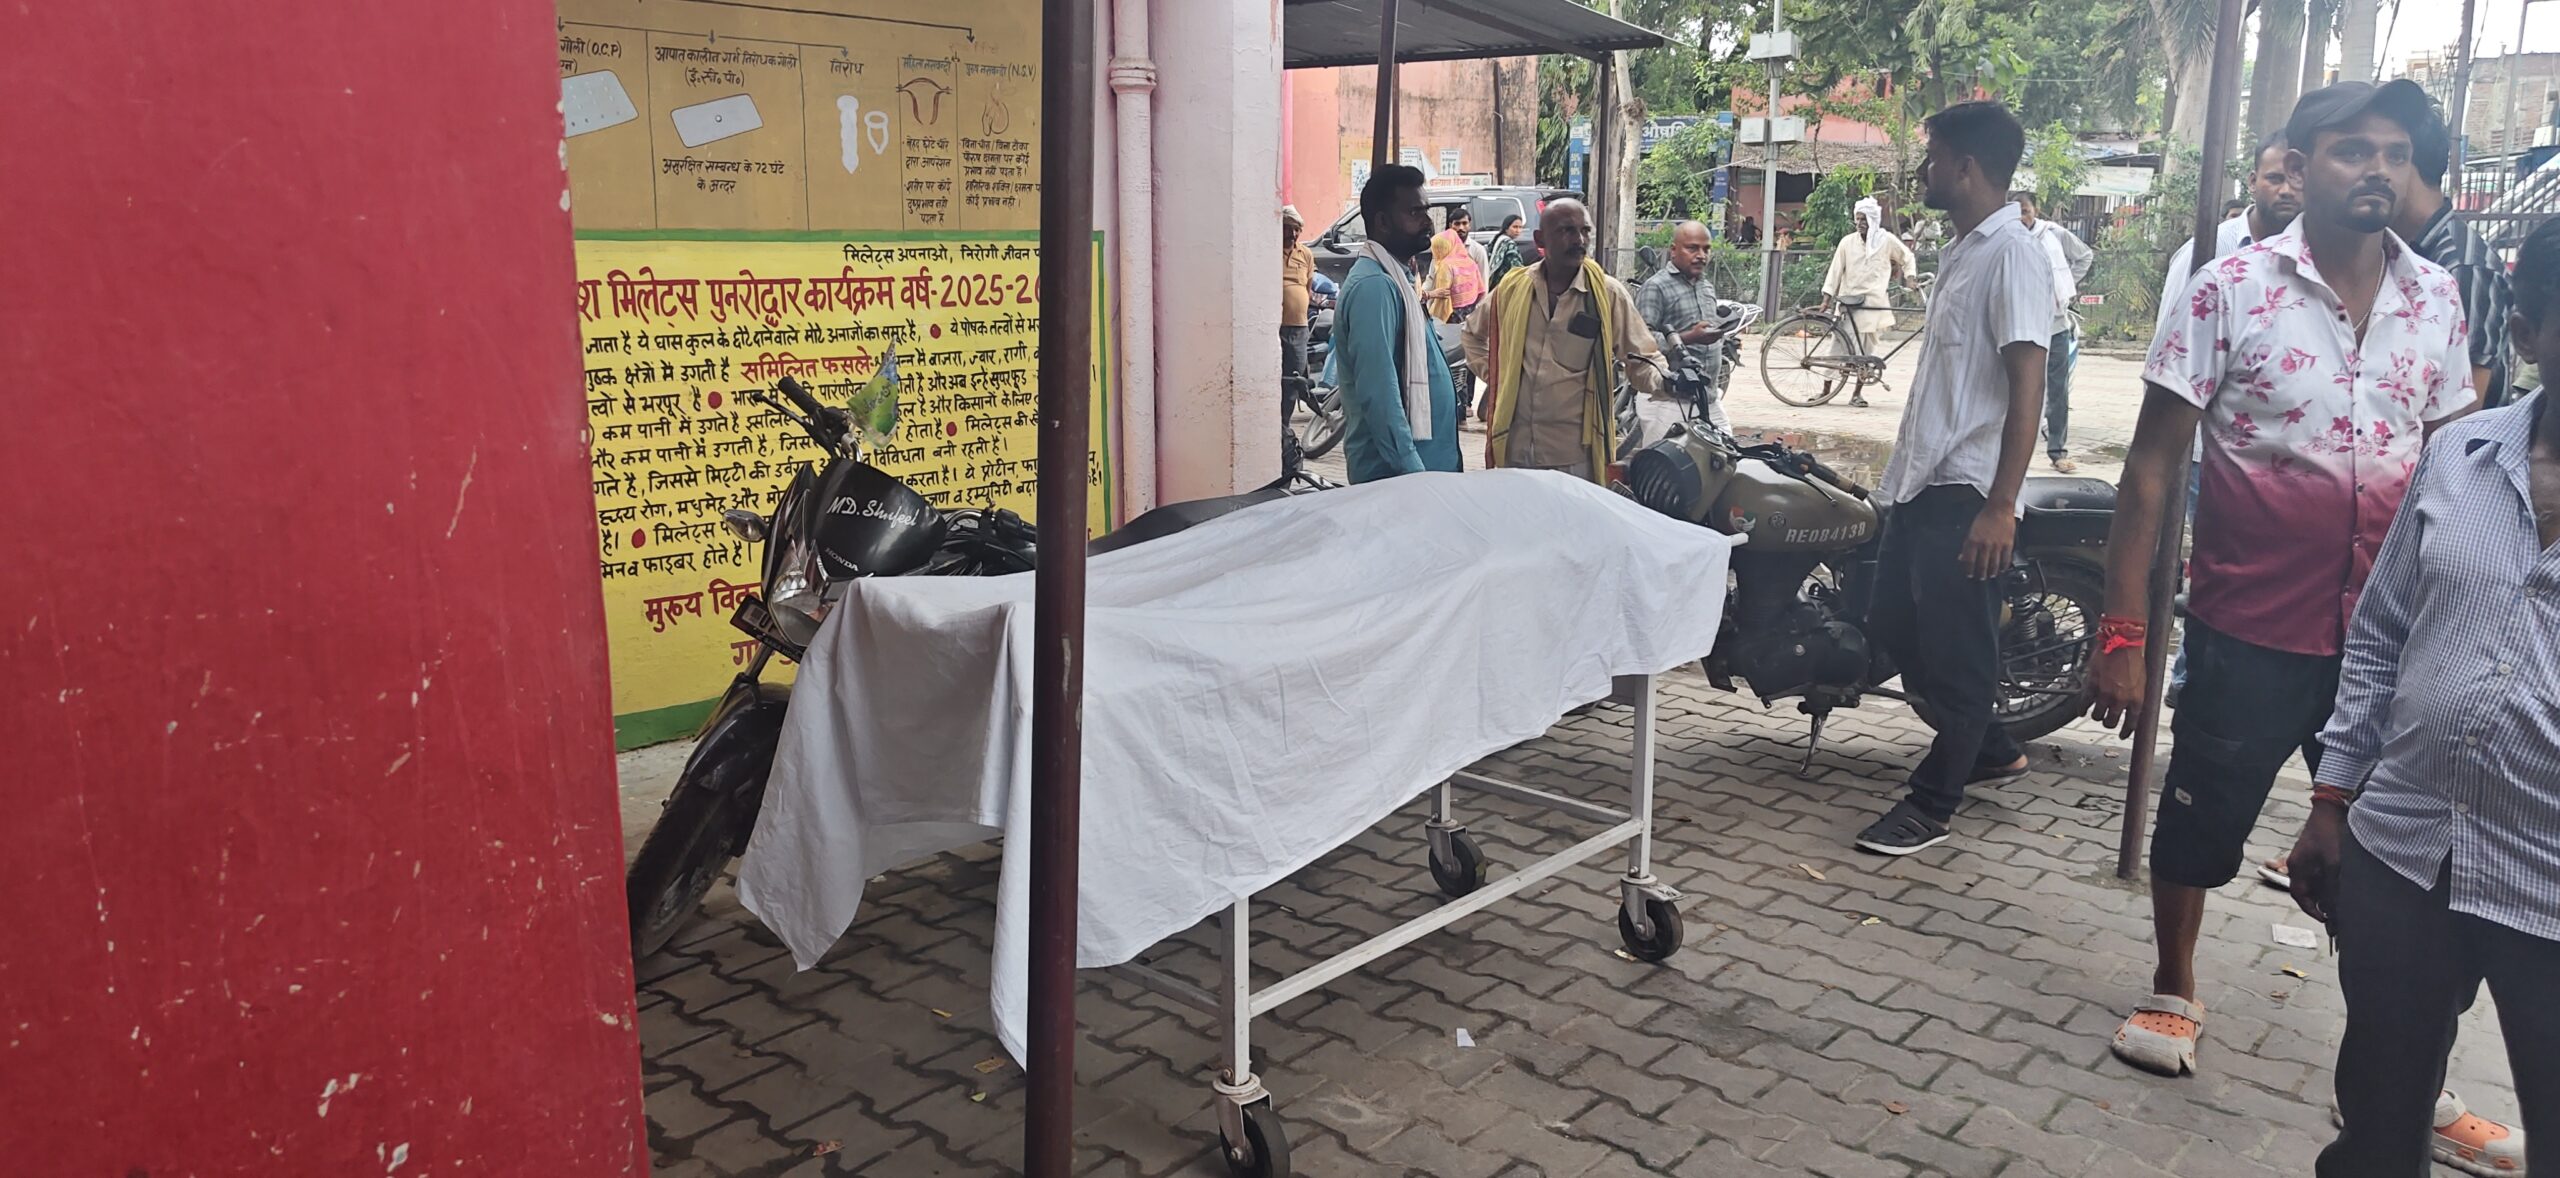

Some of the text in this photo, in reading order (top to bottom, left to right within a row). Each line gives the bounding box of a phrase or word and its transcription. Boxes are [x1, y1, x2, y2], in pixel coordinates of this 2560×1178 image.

[830, 59, 864, 76] निरोध
[744, 159, 753, 174] के
[756, 162, 767, 174] 72
[697, 177, 706, 192] के
[843, 244, 894, 270] मिलेट्स
[960, 244, 999, 262] निरोगी
[1001, 244, 1031, 262] जीवन
[607, 266, 700, 328] मिलेट्स
[804, 265, 896, 317] कार्यक्रम
[621, 329, 632, 355] है
[637, 329, 649, 351] ये
[654, 334, 683, 351] घास
[717, 326, 730, 348] के
[950, 317, 960, 336] ये
[1015, 311, 1026, 335] से
[681, 358, 717, 383] उगती
[720, 356, 731, 382] है
[623, 388, 636, 416] से
[639, 394, 687, 419] भरपूर
[690, 384, 702, 412] है
[928, 371, 949, 393] और
[949, 373, 967, 389] अब
[602, 424, 632, 442] कम
[637, 416, 671, 440] पानी
[679, 414, 693, 436] में
[698, 413, 729, 436] उगते
[731, 410, 741, 434] है
[929, 394, 951, 415] और
[953, 392, 997, 412] किसानों
[620, 449, 651, 468] कम
[656, 444, 692, 463] पानी
[713, 436, 753, 459] उगती
[906, 418, 933, 443] होता
[966, 413, 1012, 435] मिलेट्स
[1013, 411, 1029, 429] की
[648, 465, 702, 494] जिससे
[705, 461, 748, 488] मिट्टी
[749, 460, 771, 480] की
[874, 444, 926, 467] विविधता
[932, 440, 957, 458] बनी
[961, 437, 991, 460] रहती
[732, 487, 760, 509] और
[906, 470, 939, 488] करता
[965, 462, 975, 480] ये
[653, 521, 716, 546] मिलेट्स
[642, 552, 698, 576] फाइबर
[703, 543, 729, 569] होते
[824, 547, 860, 572] HONDA
